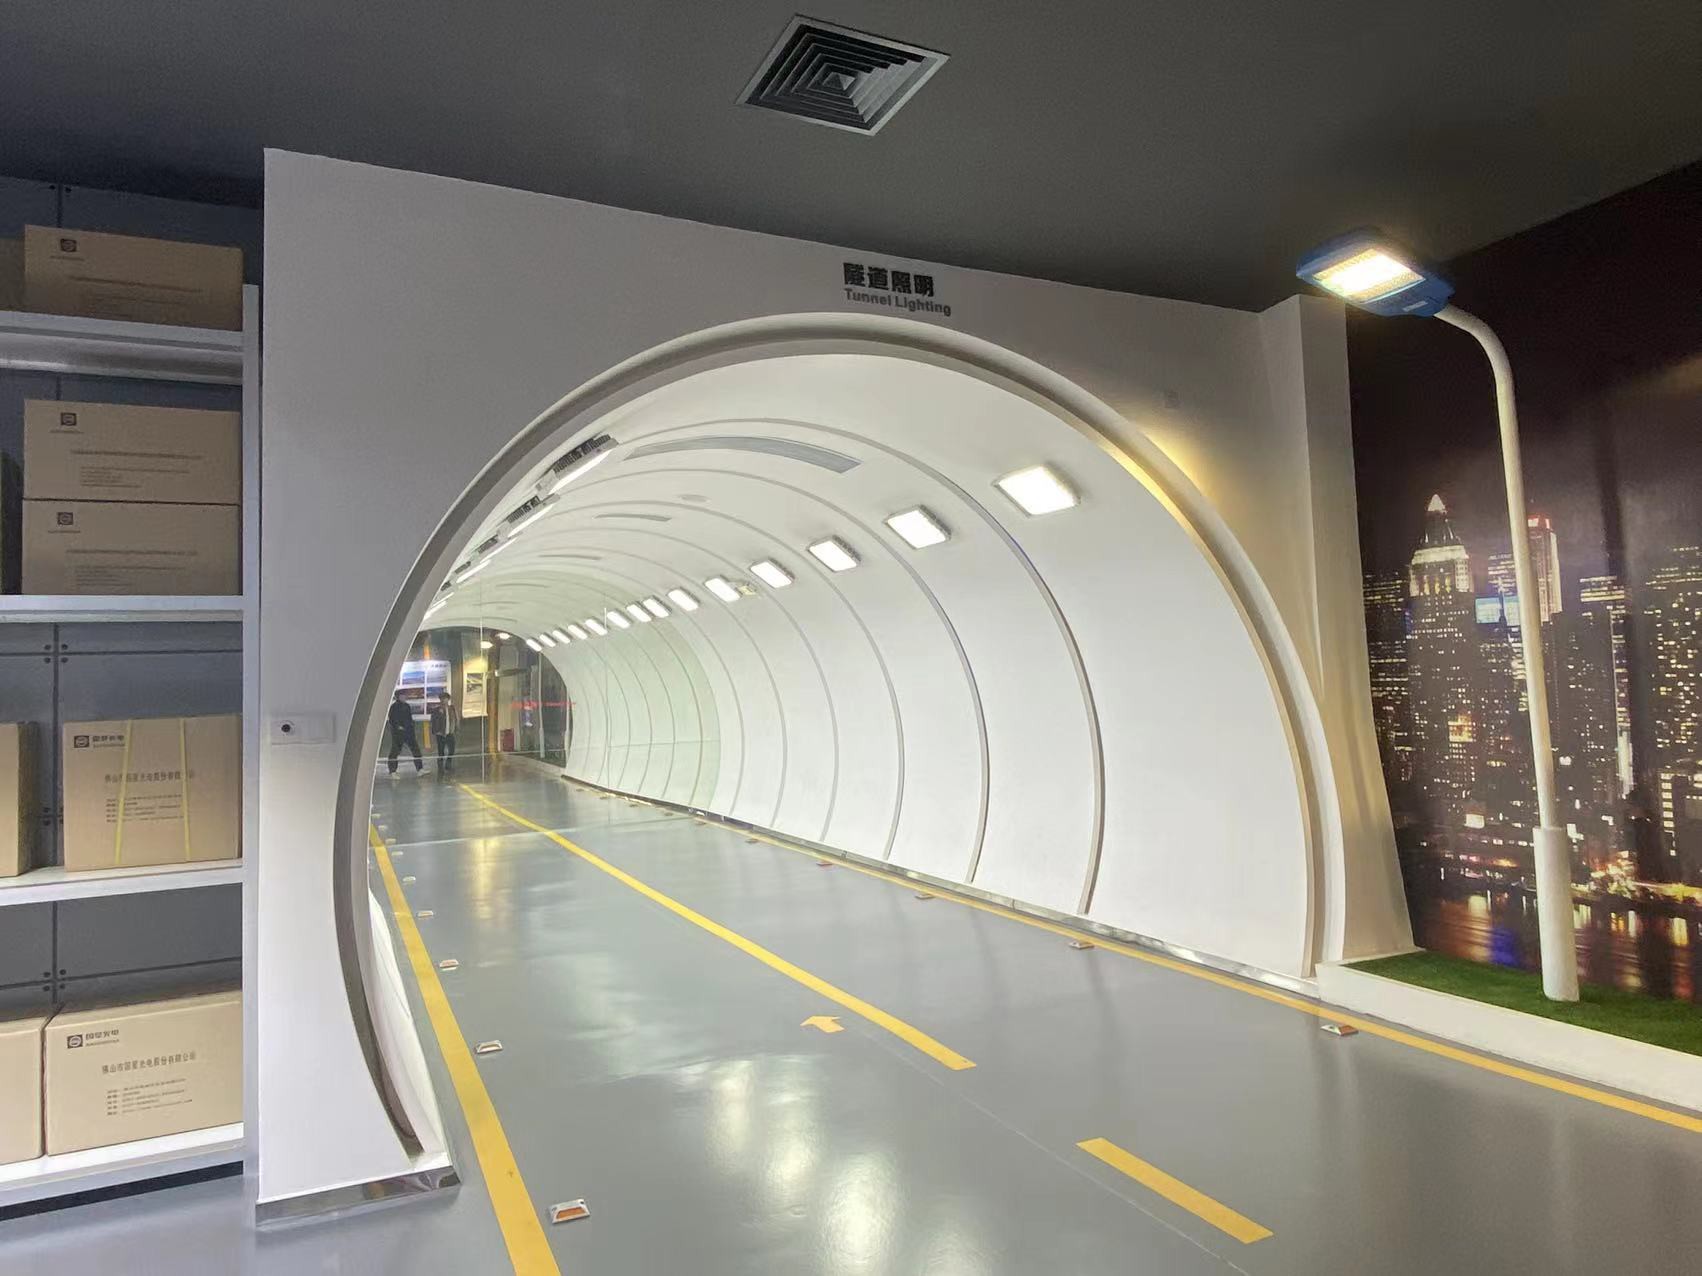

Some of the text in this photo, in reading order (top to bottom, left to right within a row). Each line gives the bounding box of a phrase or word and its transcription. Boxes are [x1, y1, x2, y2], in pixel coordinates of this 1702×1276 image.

[843, 262, 934, 297] 隧道照明
[844, 288, 952, 317] Tunnel Lighting
